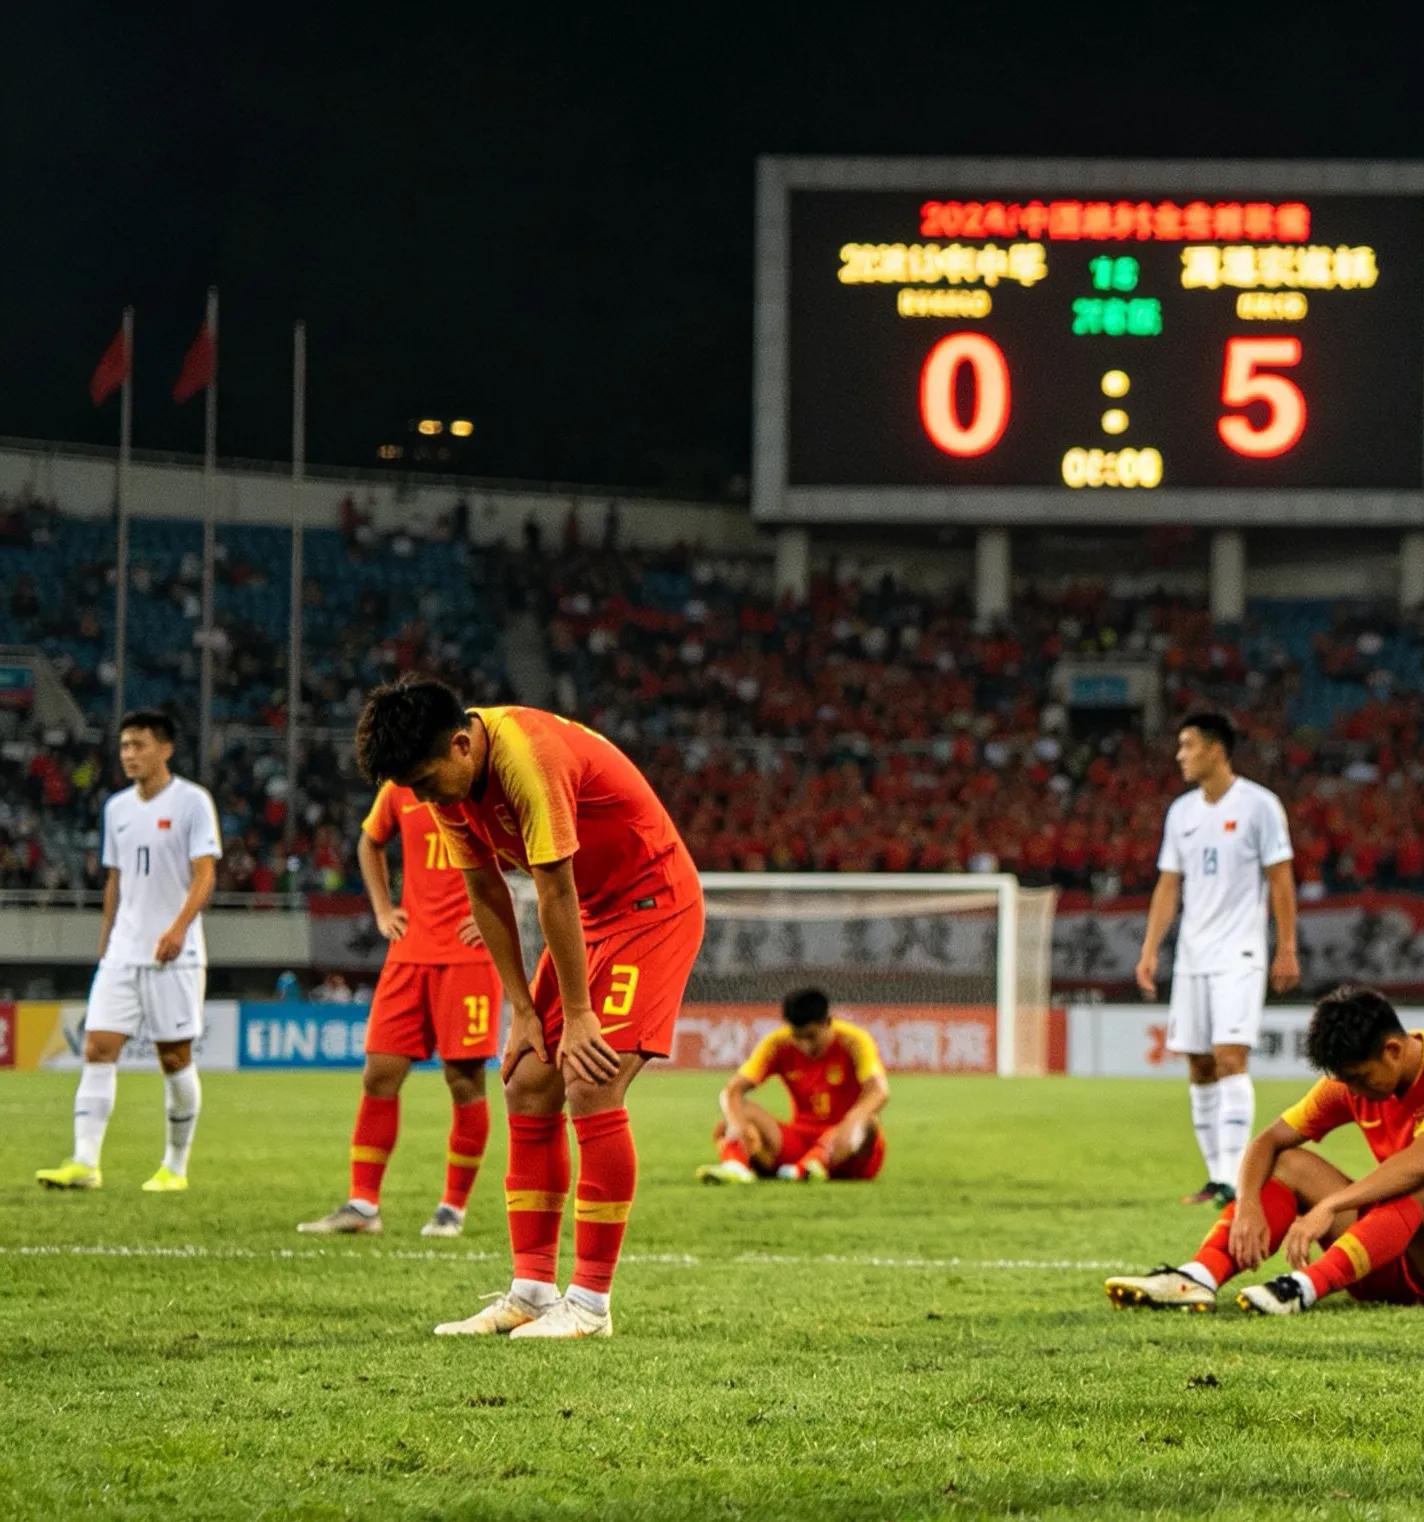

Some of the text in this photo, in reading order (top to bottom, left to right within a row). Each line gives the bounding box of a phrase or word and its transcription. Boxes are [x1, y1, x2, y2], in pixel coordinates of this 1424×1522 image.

[918, 331, 1011, 458] 0
[1217, 335, 1307, 458] 5
[602, 965, 639, 1016] 3
